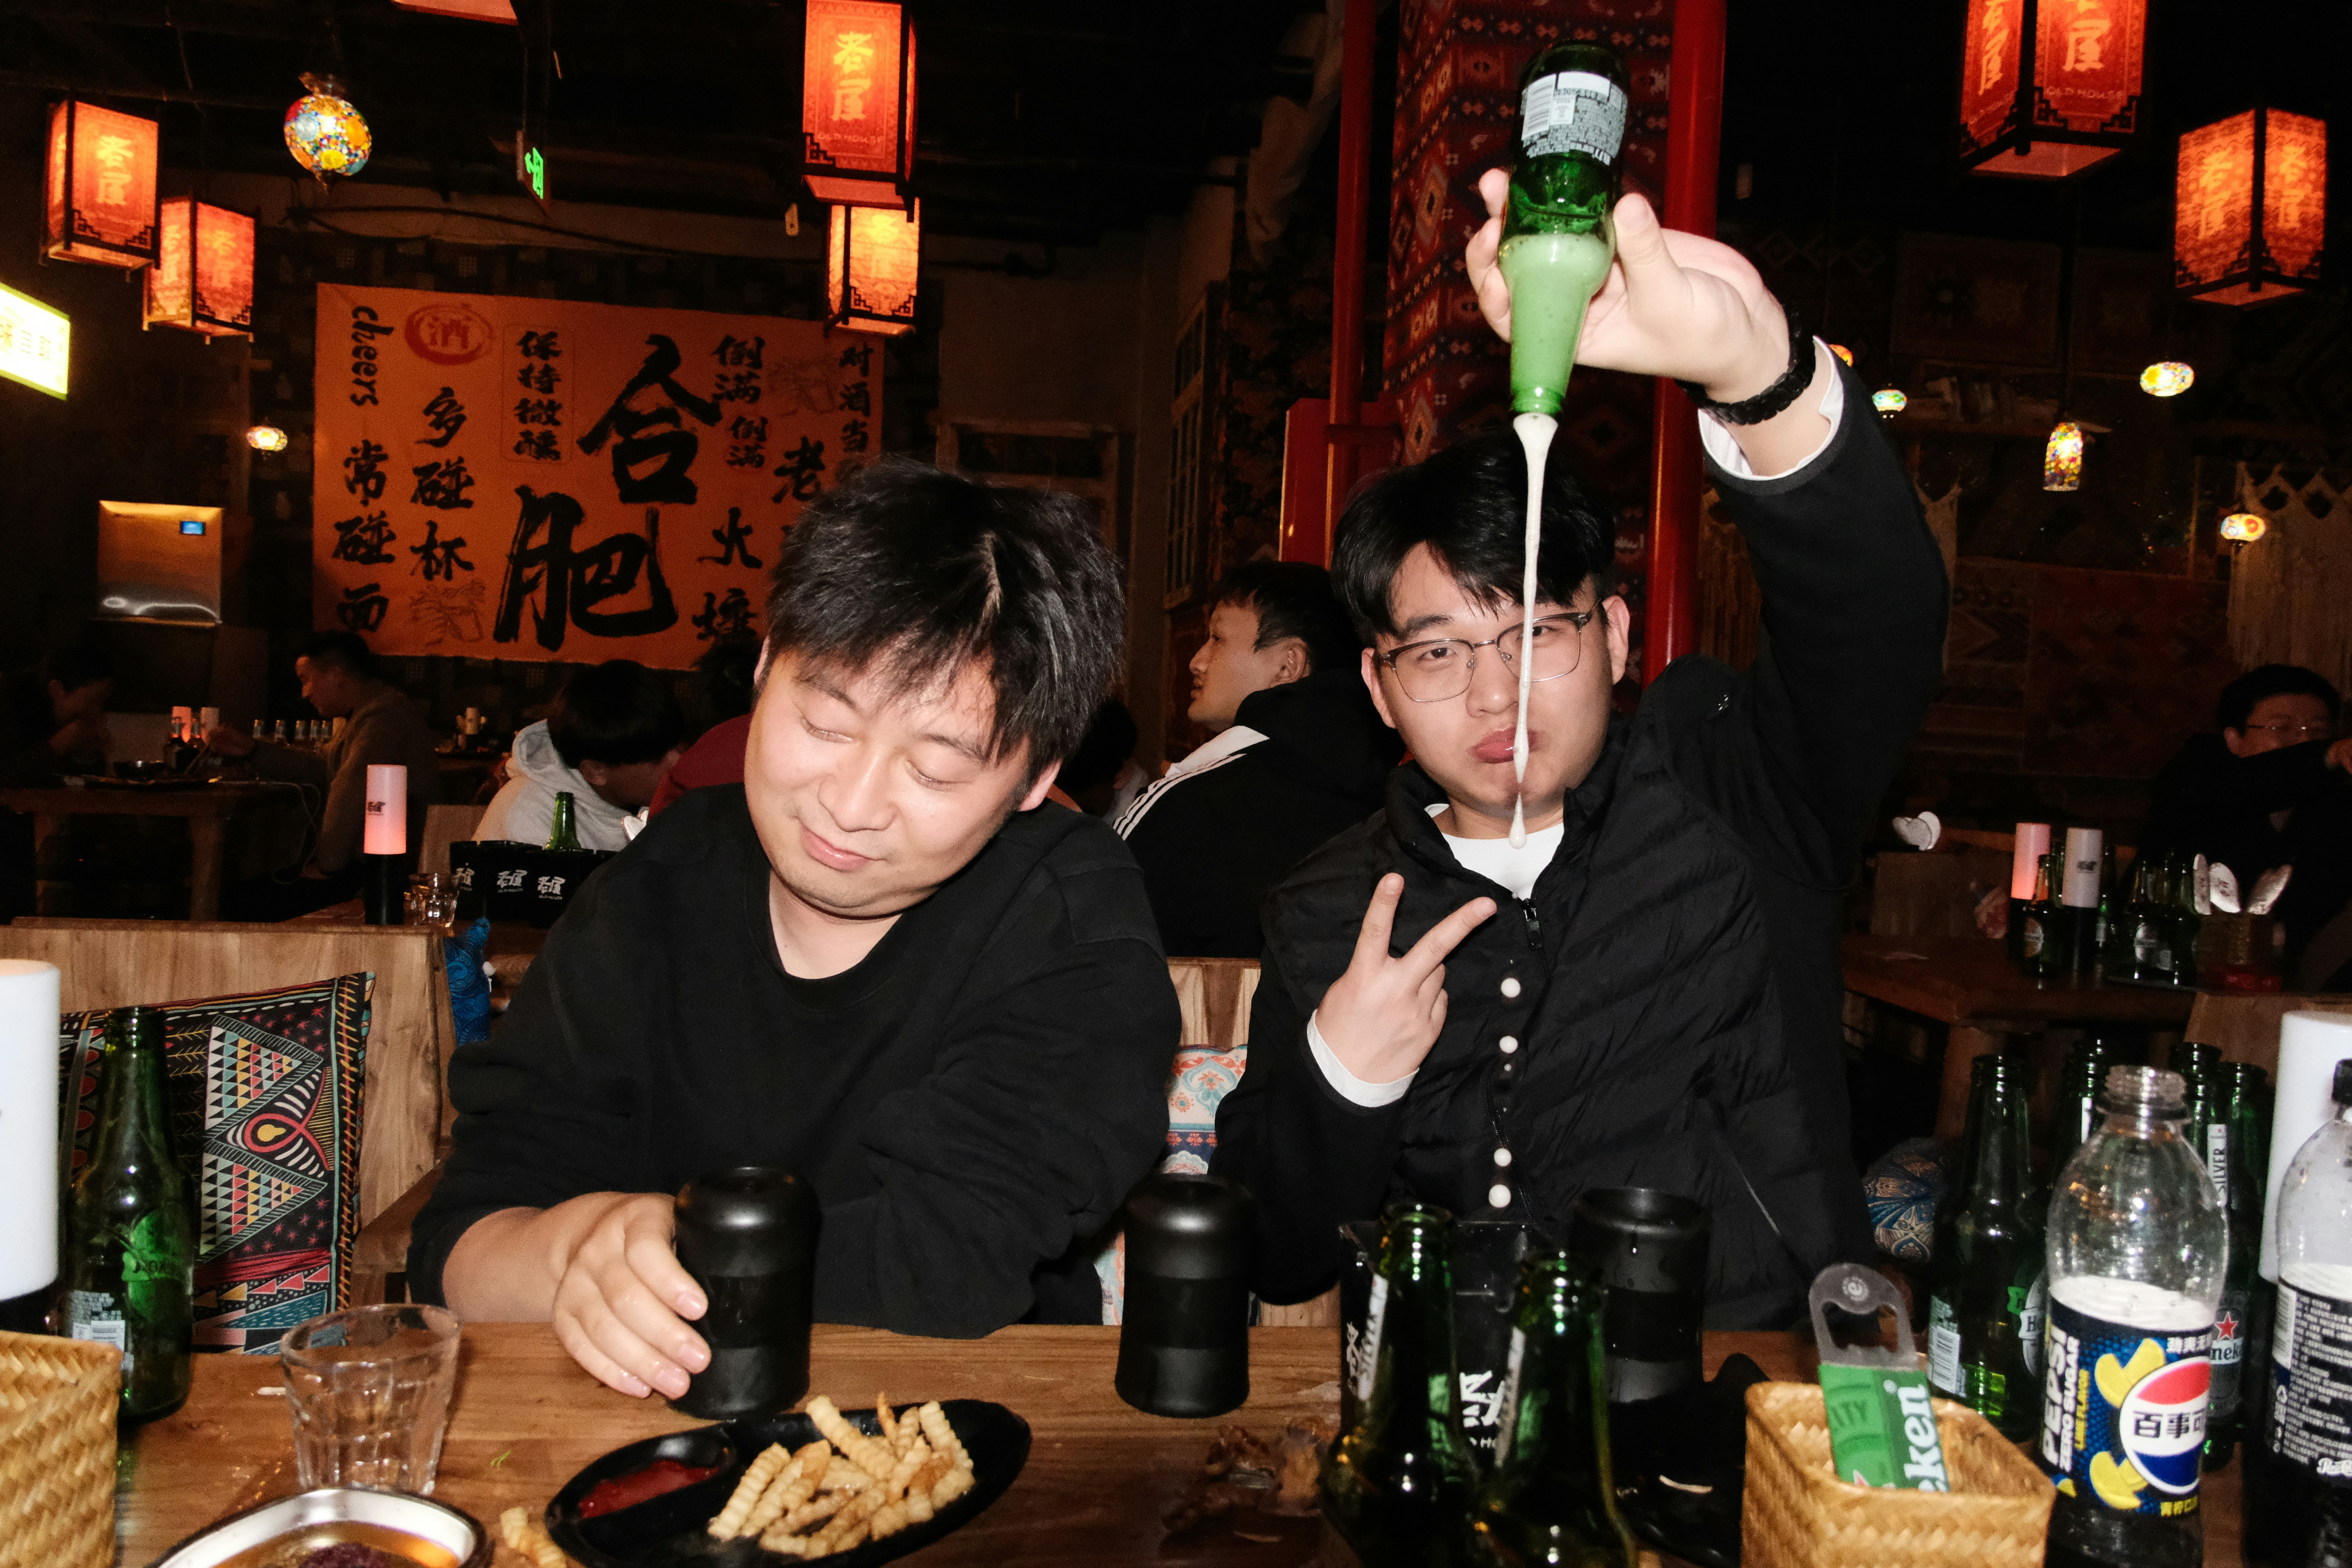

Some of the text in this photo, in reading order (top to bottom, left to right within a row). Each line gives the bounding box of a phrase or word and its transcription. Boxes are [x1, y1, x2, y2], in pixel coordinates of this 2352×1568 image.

[831, 31, 874, 121] 老屋
[351, 306, 394, 407] cheers
[332, 439, 397, 632] 常碰面
[410, 387, 475, 581] 多碰杯
[2042, 1323, 2067, 1466] PEPSI
[2060, 1335, 2080, 1473] ZERO SUGAR
